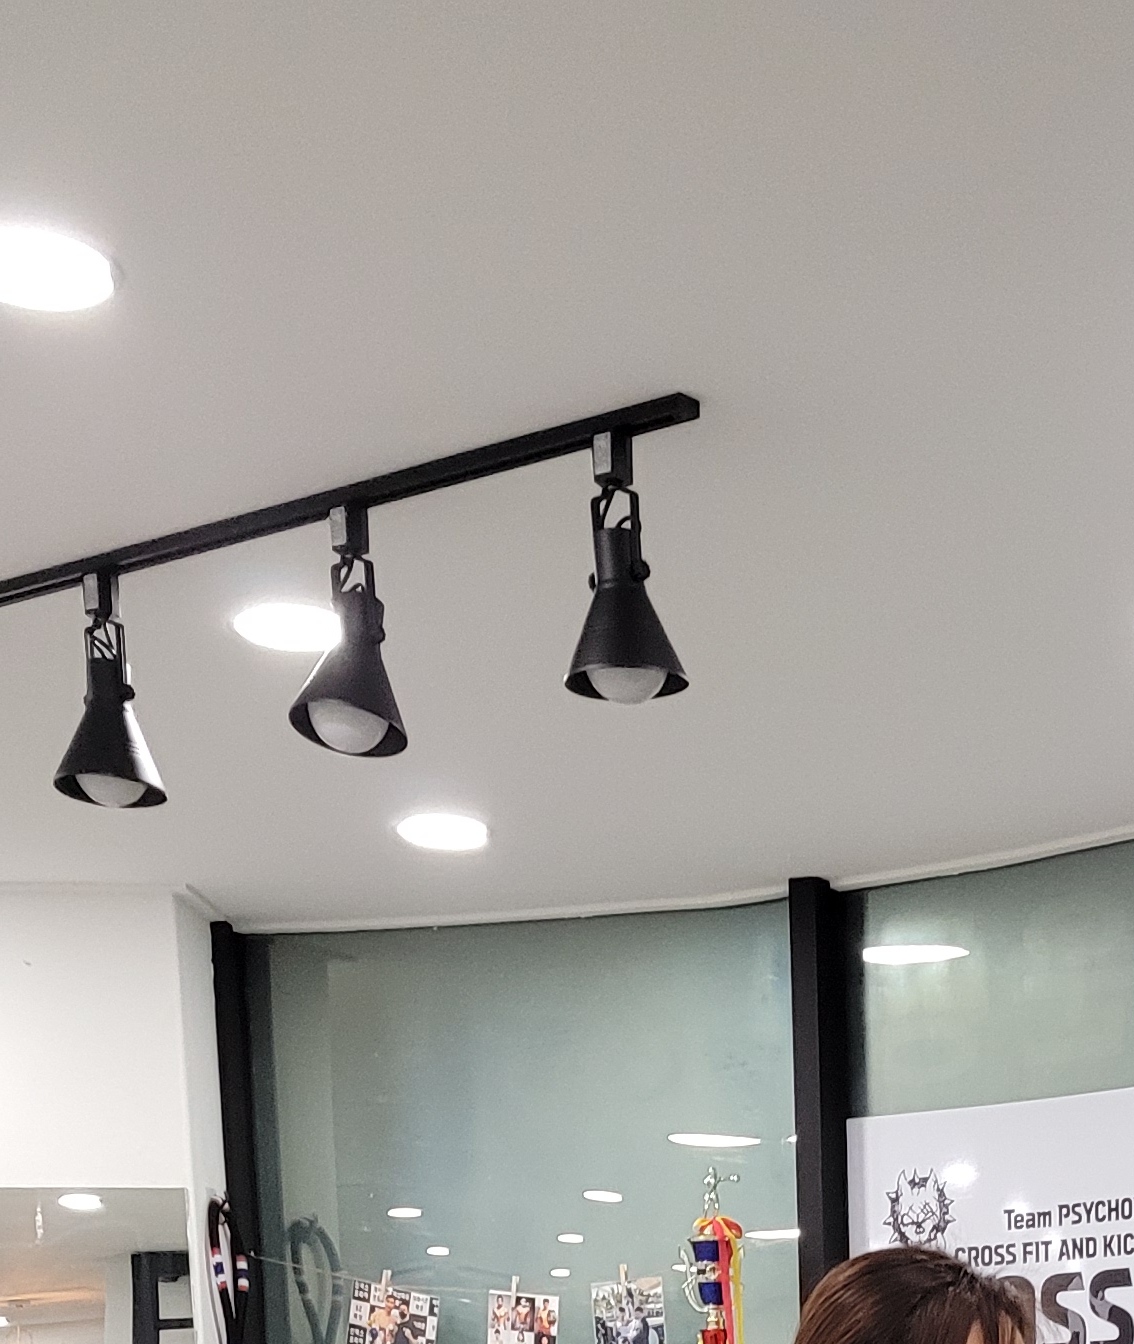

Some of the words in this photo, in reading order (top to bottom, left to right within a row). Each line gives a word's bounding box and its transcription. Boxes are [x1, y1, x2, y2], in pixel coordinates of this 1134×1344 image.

[1003, 1208, 1052, 1230] Team
[1022, 1240, 1052, 1264] FIT
[1057, 1236, 1097, 1262] AND
